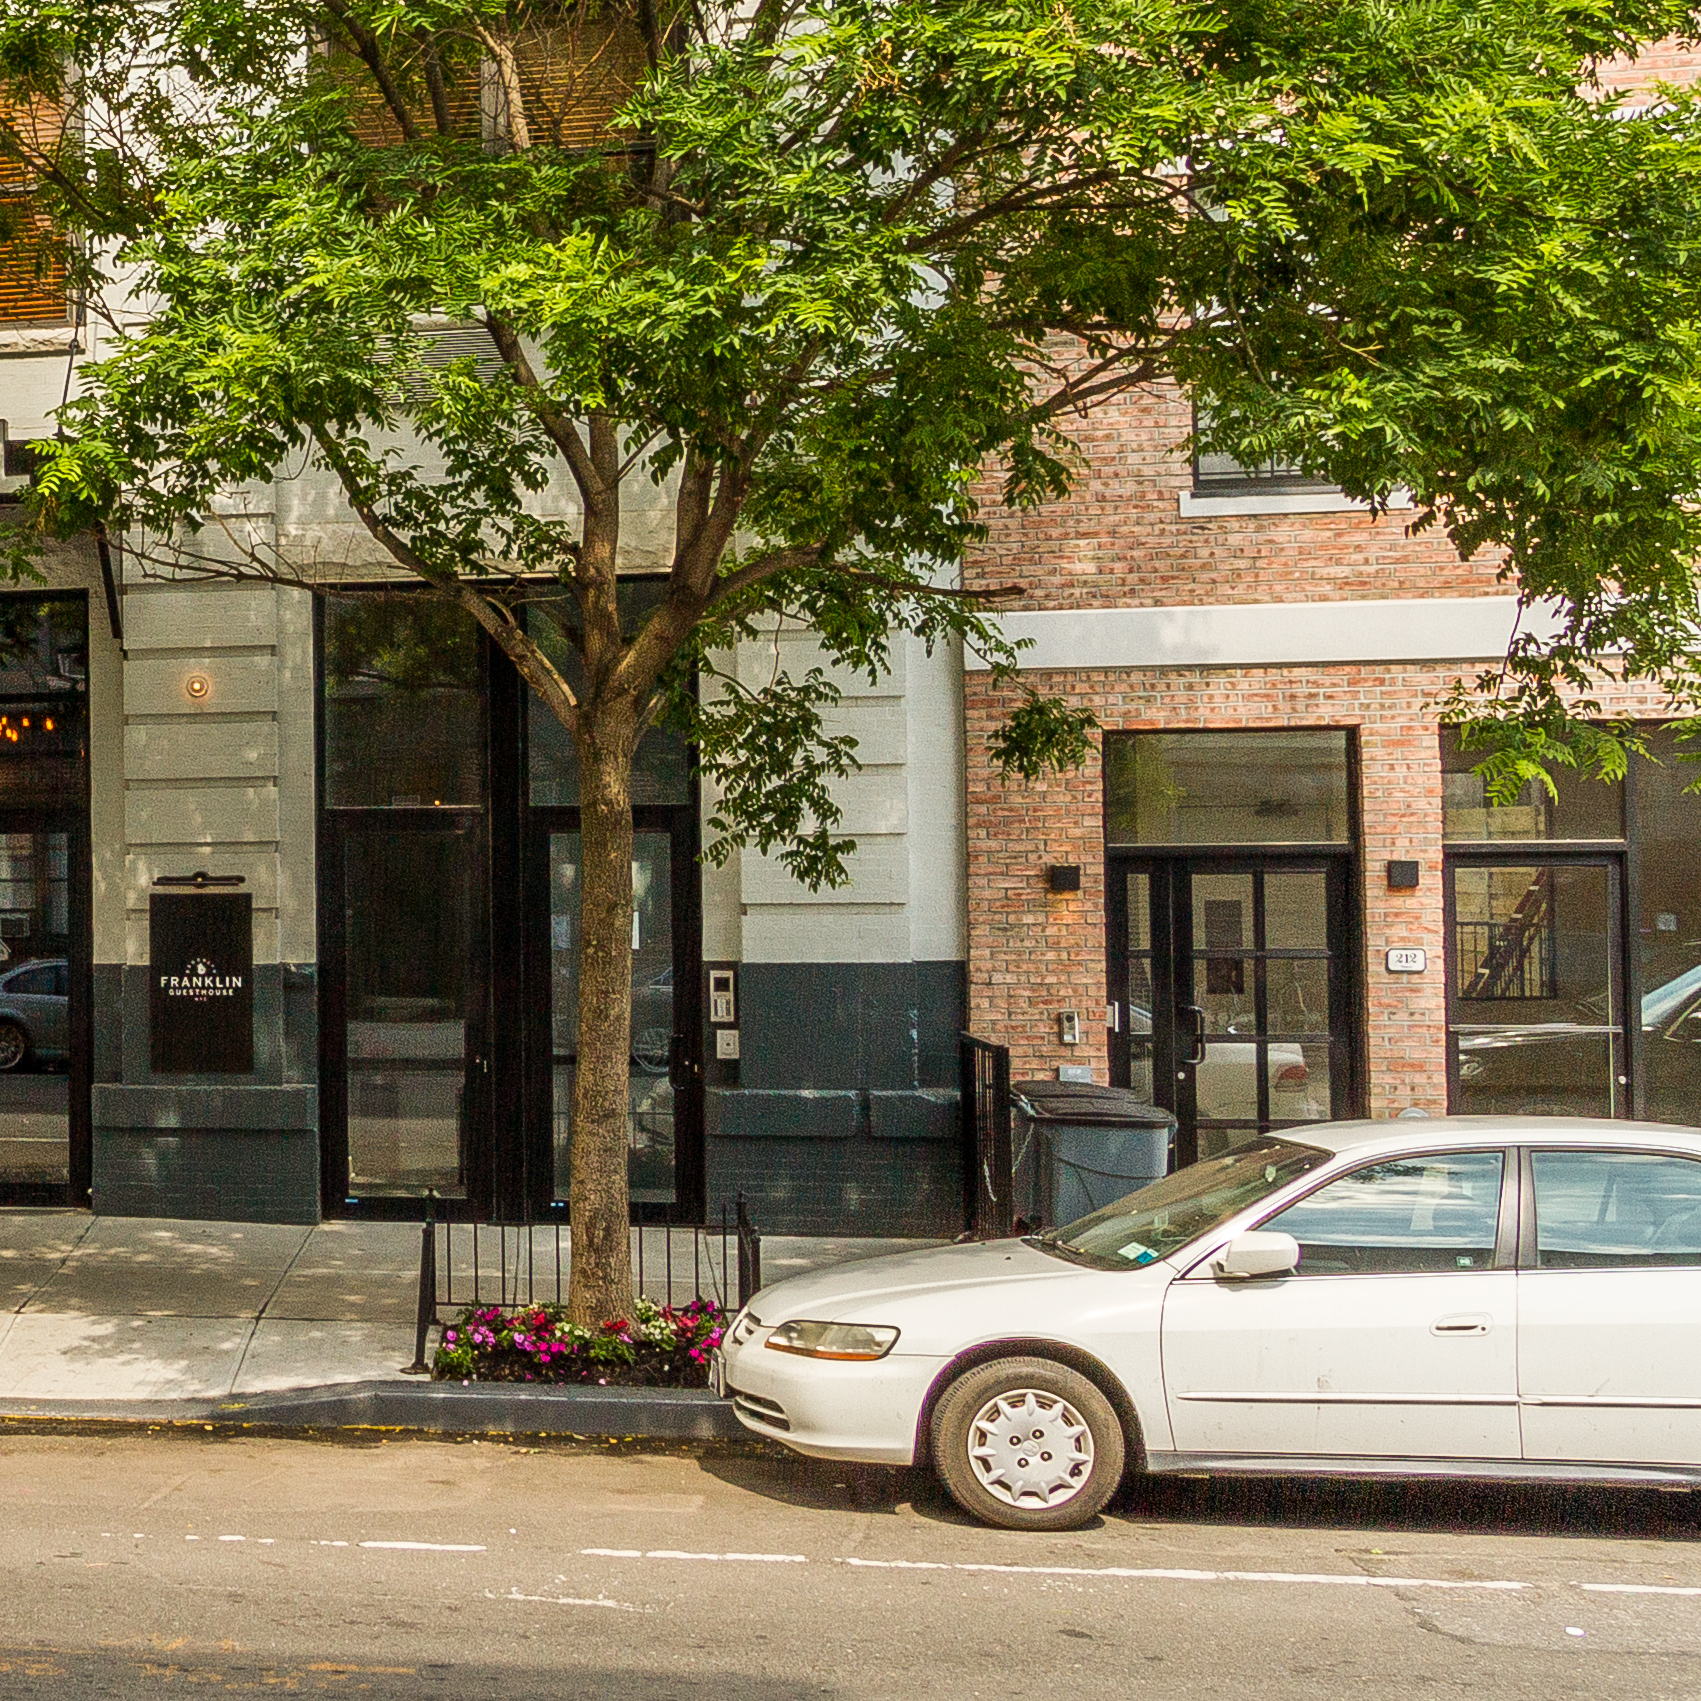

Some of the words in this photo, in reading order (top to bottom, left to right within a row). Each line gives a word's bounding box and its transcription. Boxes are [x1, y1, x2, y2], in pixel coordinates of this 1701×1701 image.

[1395, 953, 1417, 964] 212
[160, 976, 242, 988] FRANKLIN
[168, 988, 234, 996] GUESTHOUSE
